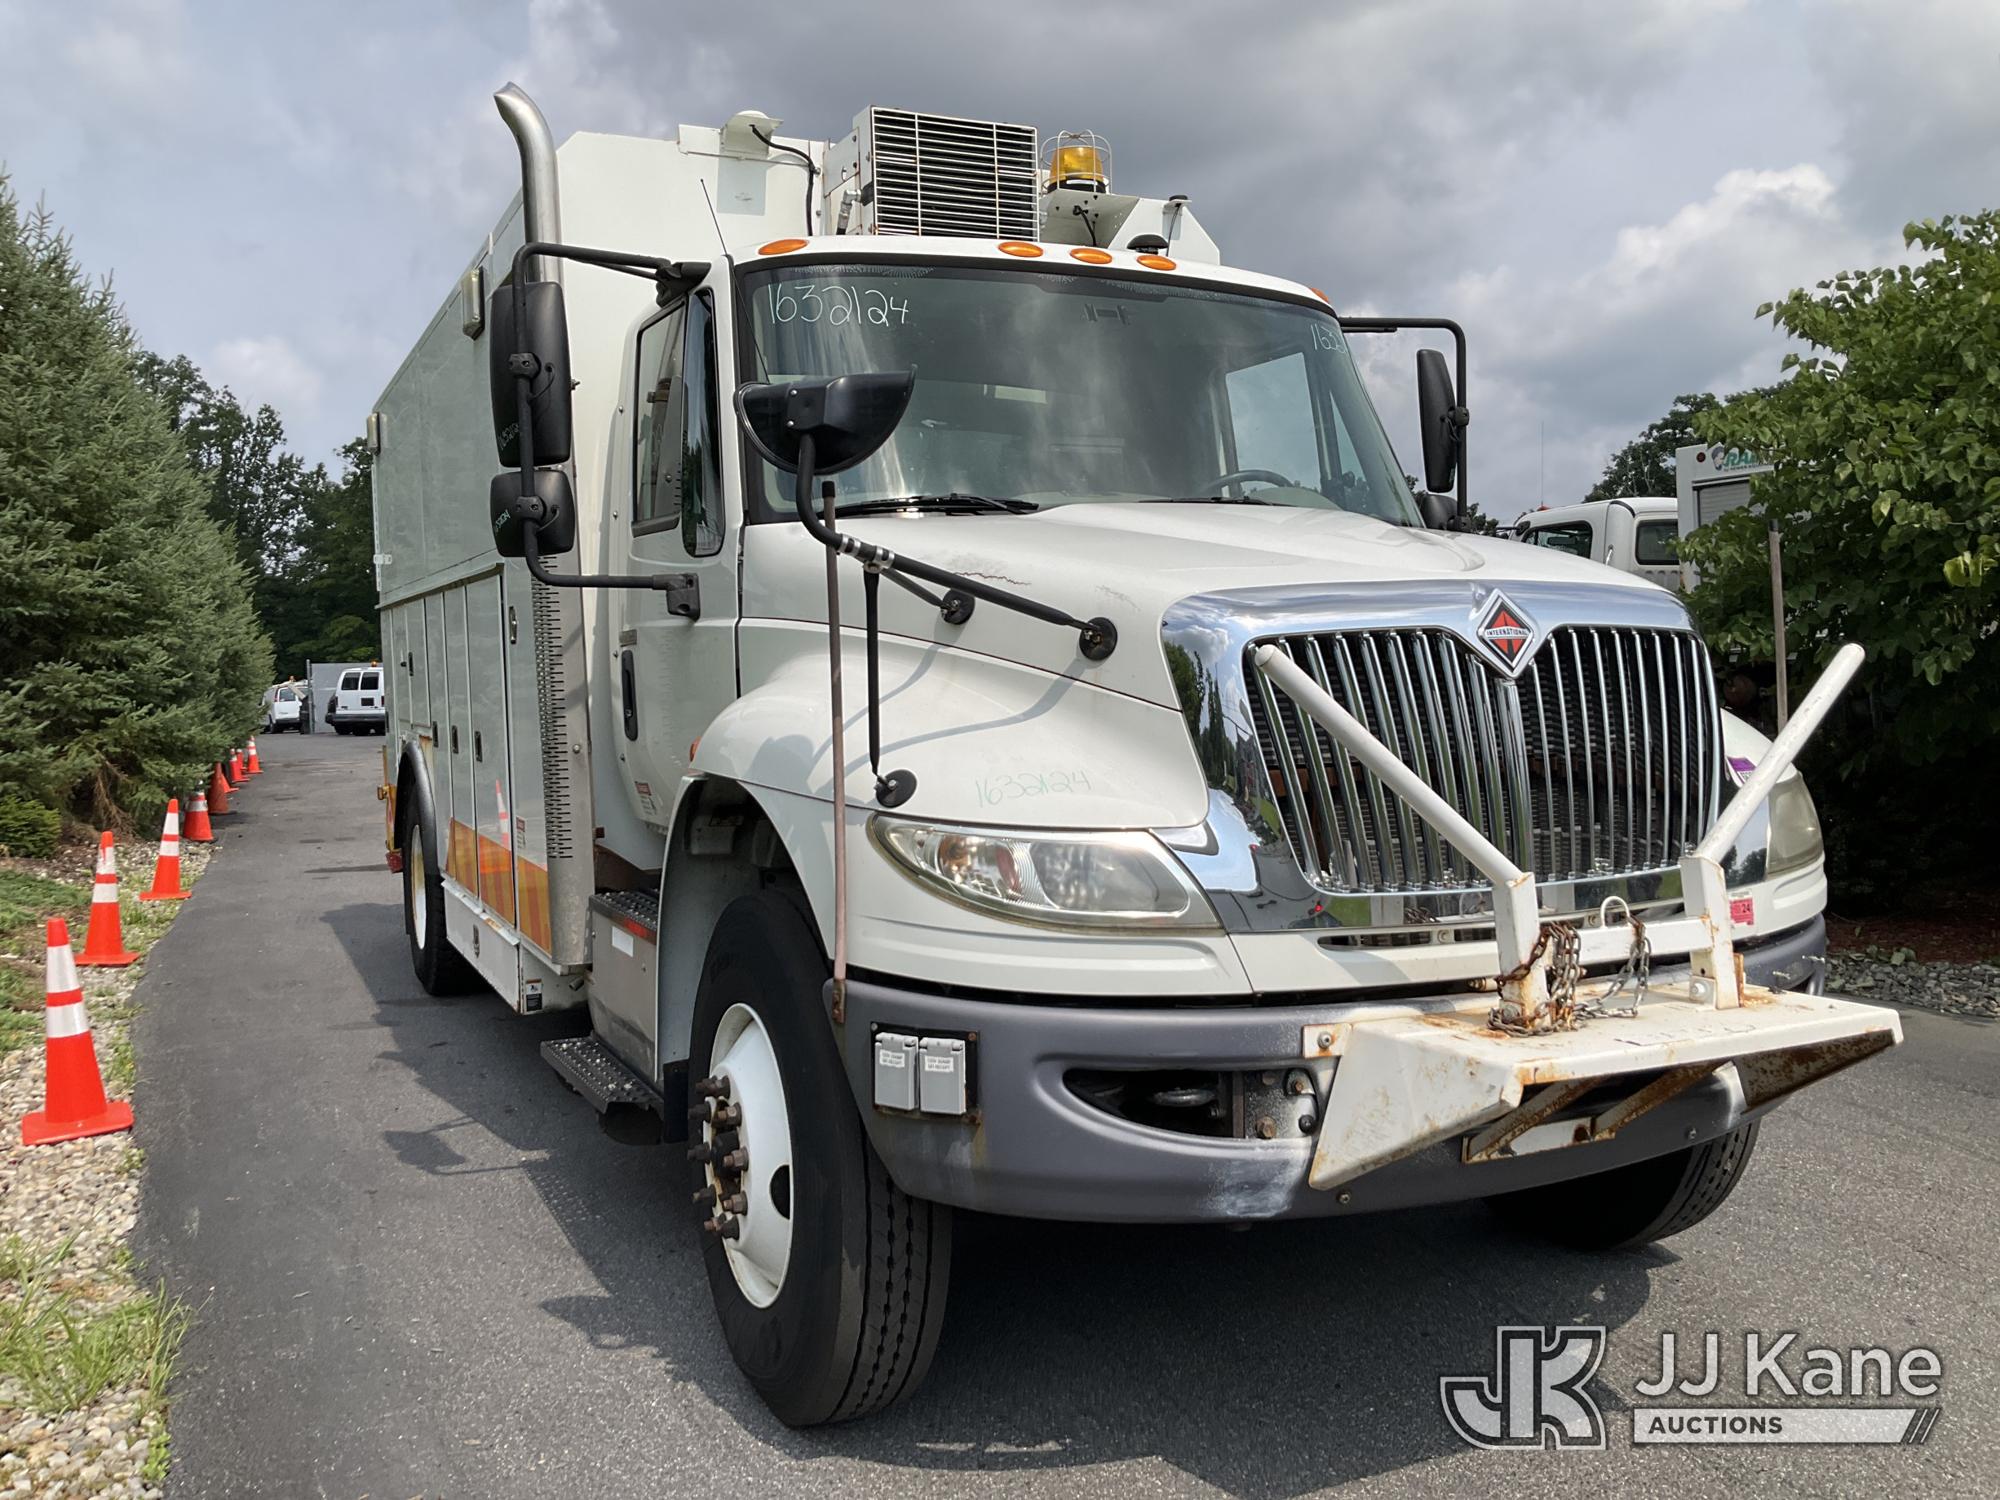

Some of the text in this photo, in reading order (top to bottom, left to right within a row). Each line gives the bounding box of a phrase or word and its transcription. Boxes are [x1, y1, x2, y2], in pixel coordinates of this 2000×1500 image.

[768, 283, 909, 327] 1632124
[1487, 628, 1528, 636] INTERNATIONAL
[975, 770, 1092, 808] 1632124
